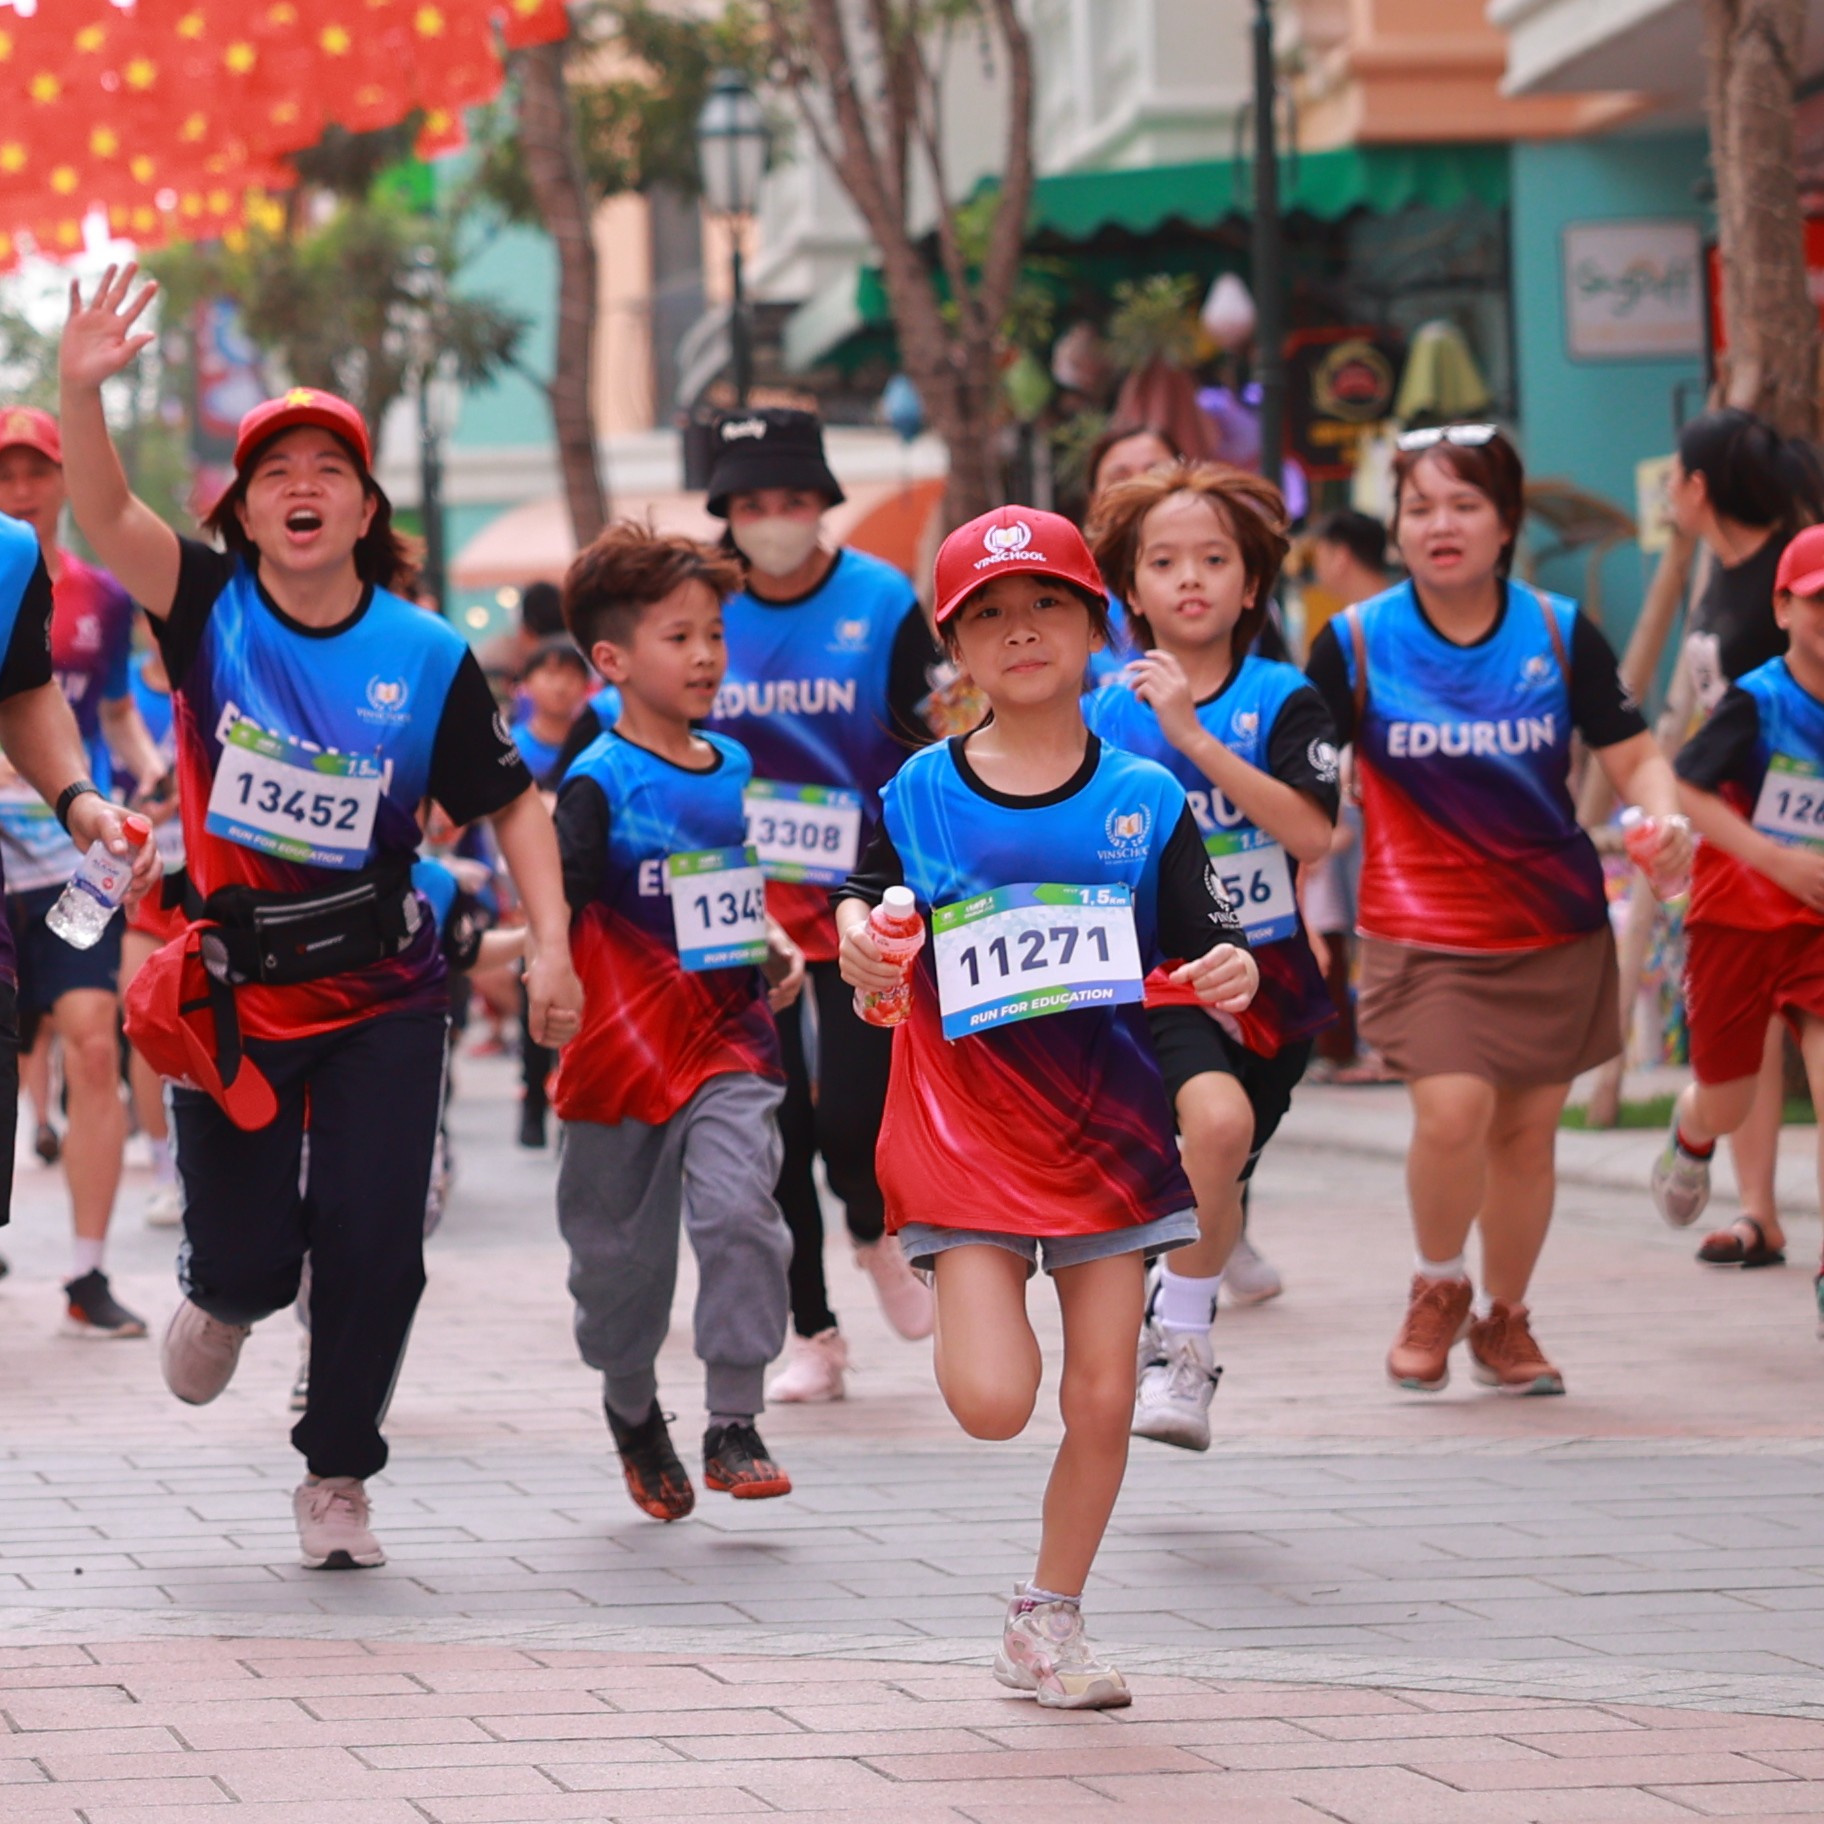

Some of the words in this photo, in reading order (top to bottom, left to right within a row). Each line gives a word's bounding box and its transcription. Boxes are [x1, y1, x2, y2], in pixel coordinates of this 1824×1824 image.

[973, 550, 1047, 570] VINSCHOOL
[1388, 714, 1556, 758] EDURUN
[237, 772, 360, 831] 13452
[960, 926, 1111, 987] 11271
[970, 1010, 997, 1026] RUN
[1001, 1001, 1028, 1019] FOR
[1031, 988, 1113, 1011] EDUCATION
